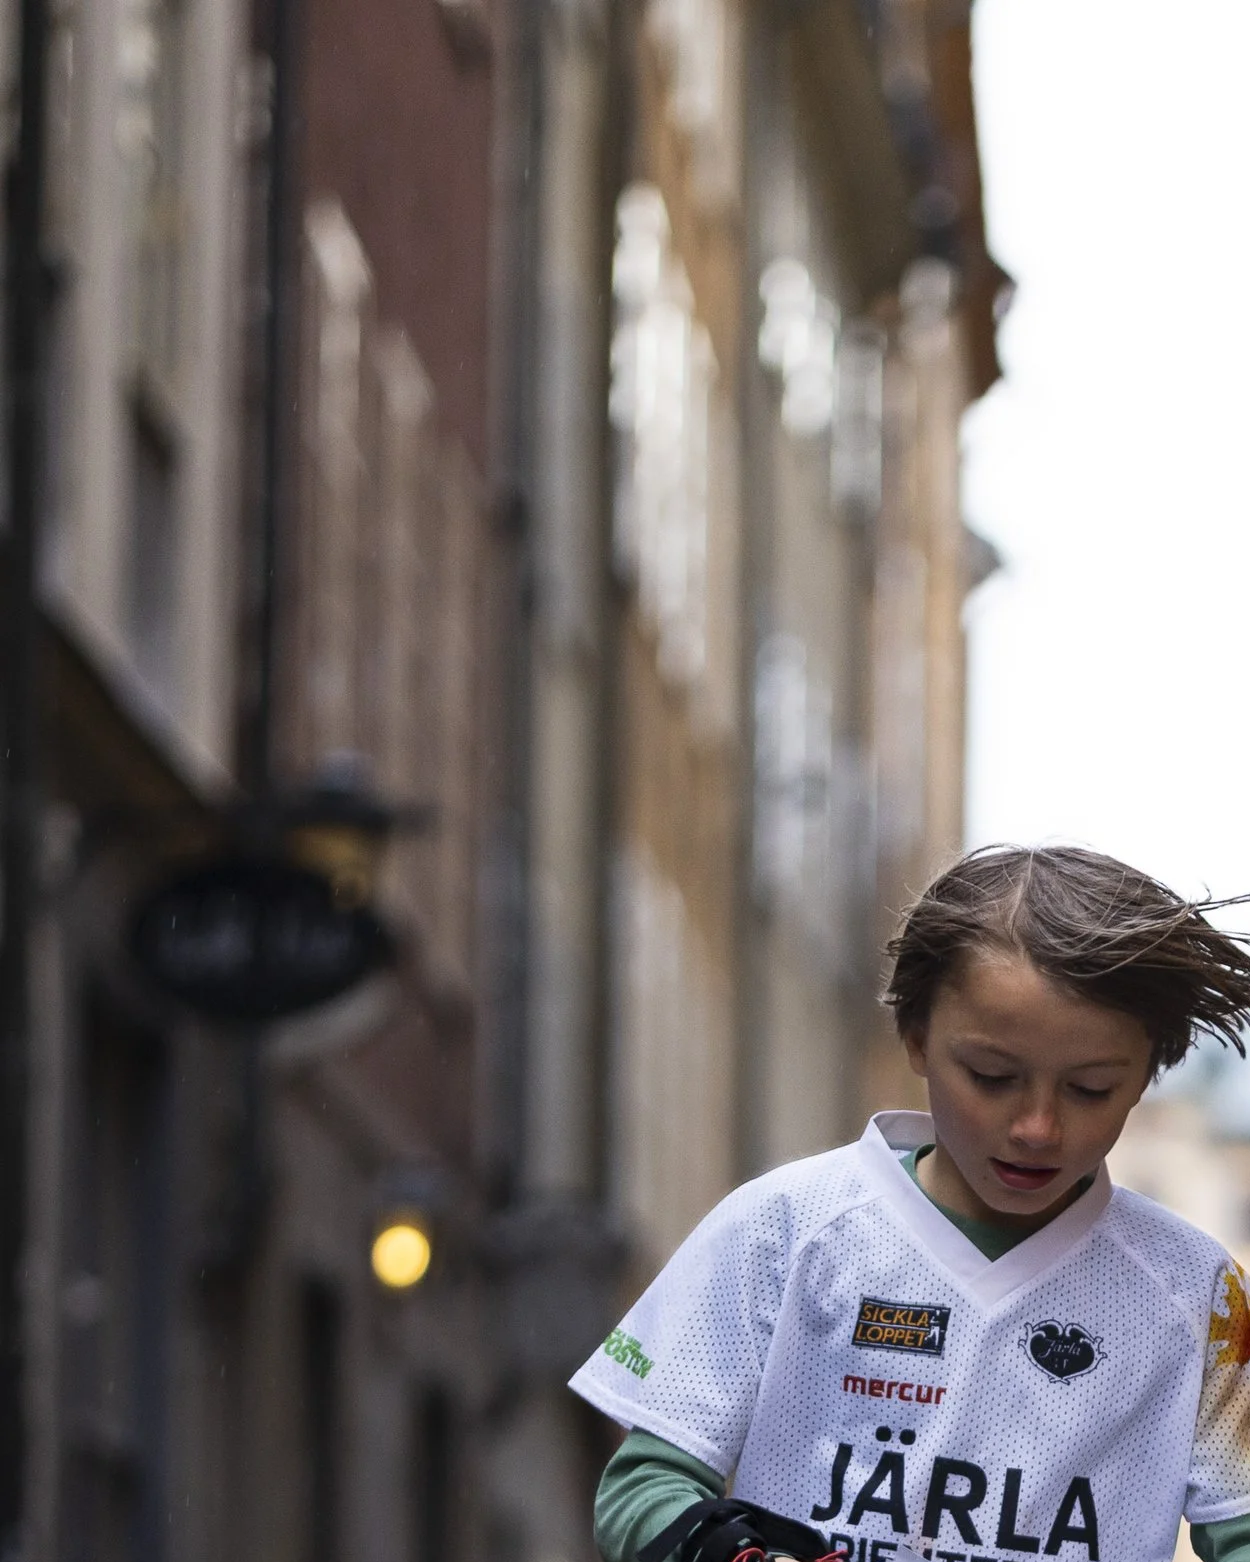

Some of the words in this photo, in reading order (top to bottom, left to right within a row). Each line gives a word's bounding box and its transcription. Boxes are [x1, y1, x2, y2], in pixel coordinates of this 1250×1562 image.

[861, 1304, 929, 1327] SICKLA
[856, 1323, 927, 1347] LOPPET
[604, 1333, 655, 1379] OSTEN
[843, 1375, 947, 1405] mercur
[810, 1426, 1100, 1562] JÄRLA
